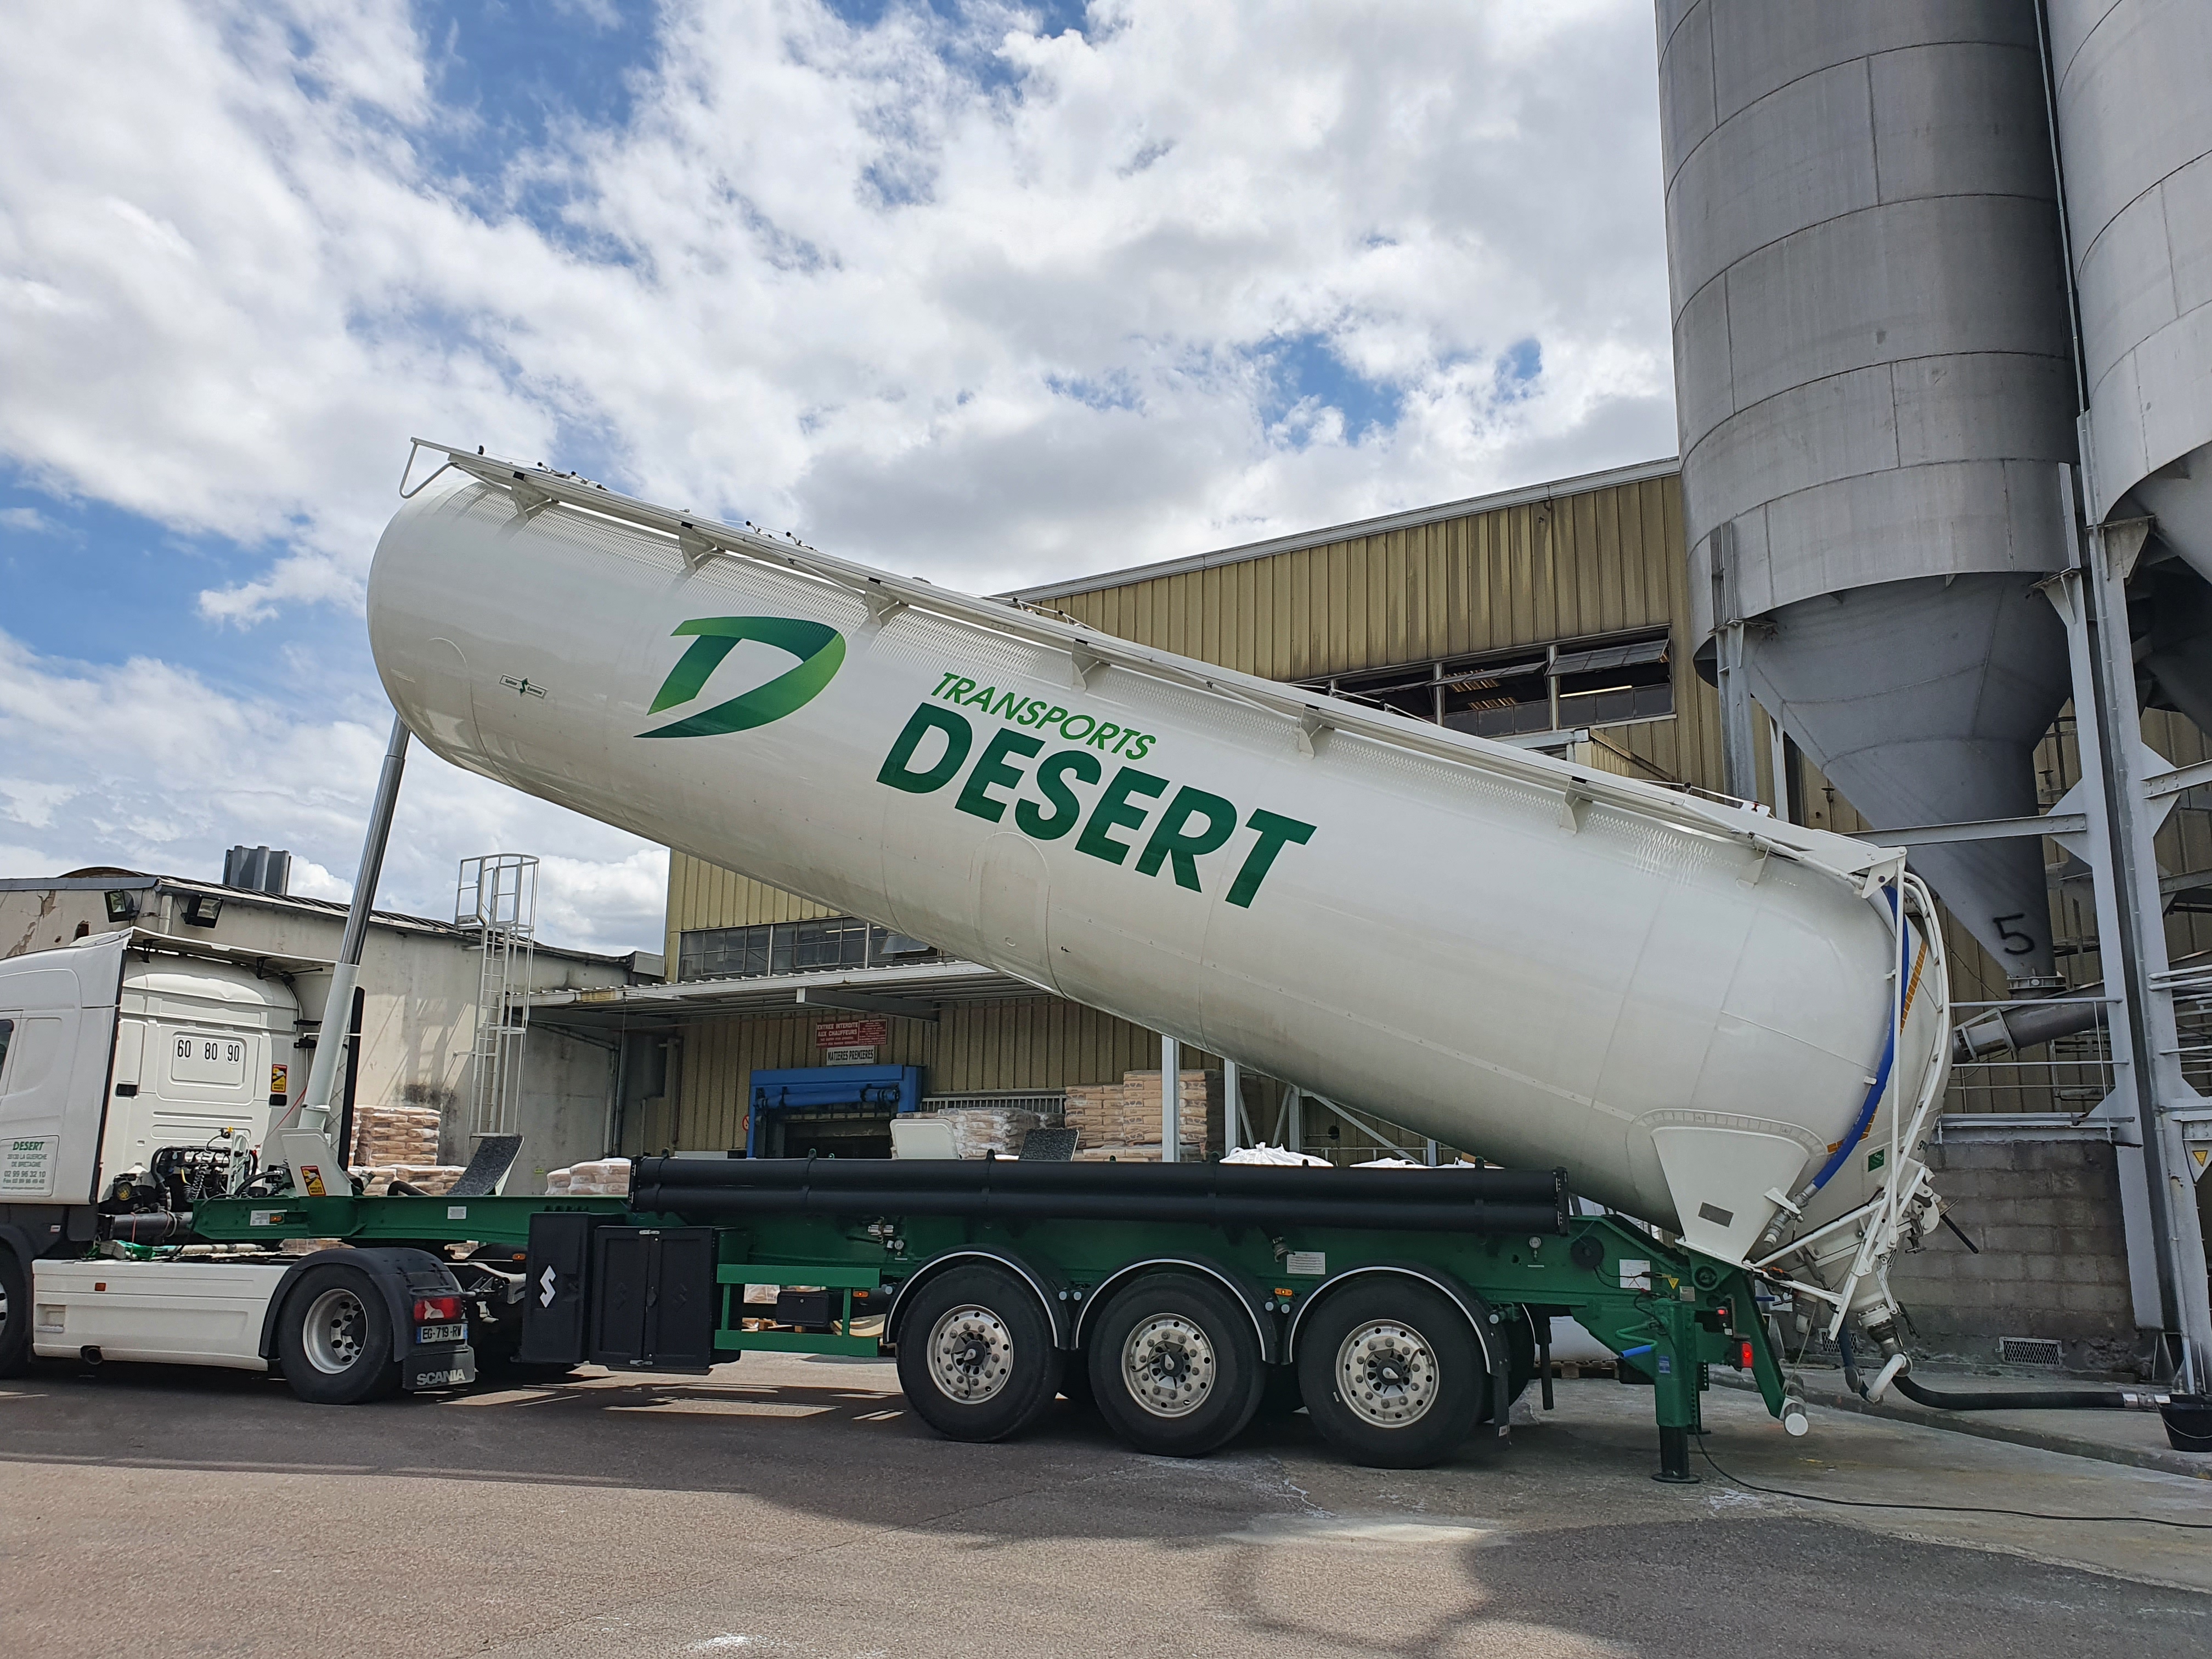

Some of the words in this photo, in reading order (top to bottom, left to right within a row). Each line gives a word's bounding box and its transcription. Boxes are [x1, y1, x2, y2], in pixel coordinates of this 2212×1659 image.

[930, 672, 1156, 760] TRANSPORTS
[876, 702, 1318, 909] DESERT
[1992, 912, 2035, 956] 5
[177, 1039, 191, 1058] 60
[205, 1042, 218, 1060] 80
[227, 1045, 240, 1062] 90
[849, 1049, 874, 1060] PREMIERES
[13, 1141, 45, 1151] DESERT
[416, 1368, 466, 1386] SCANIA
